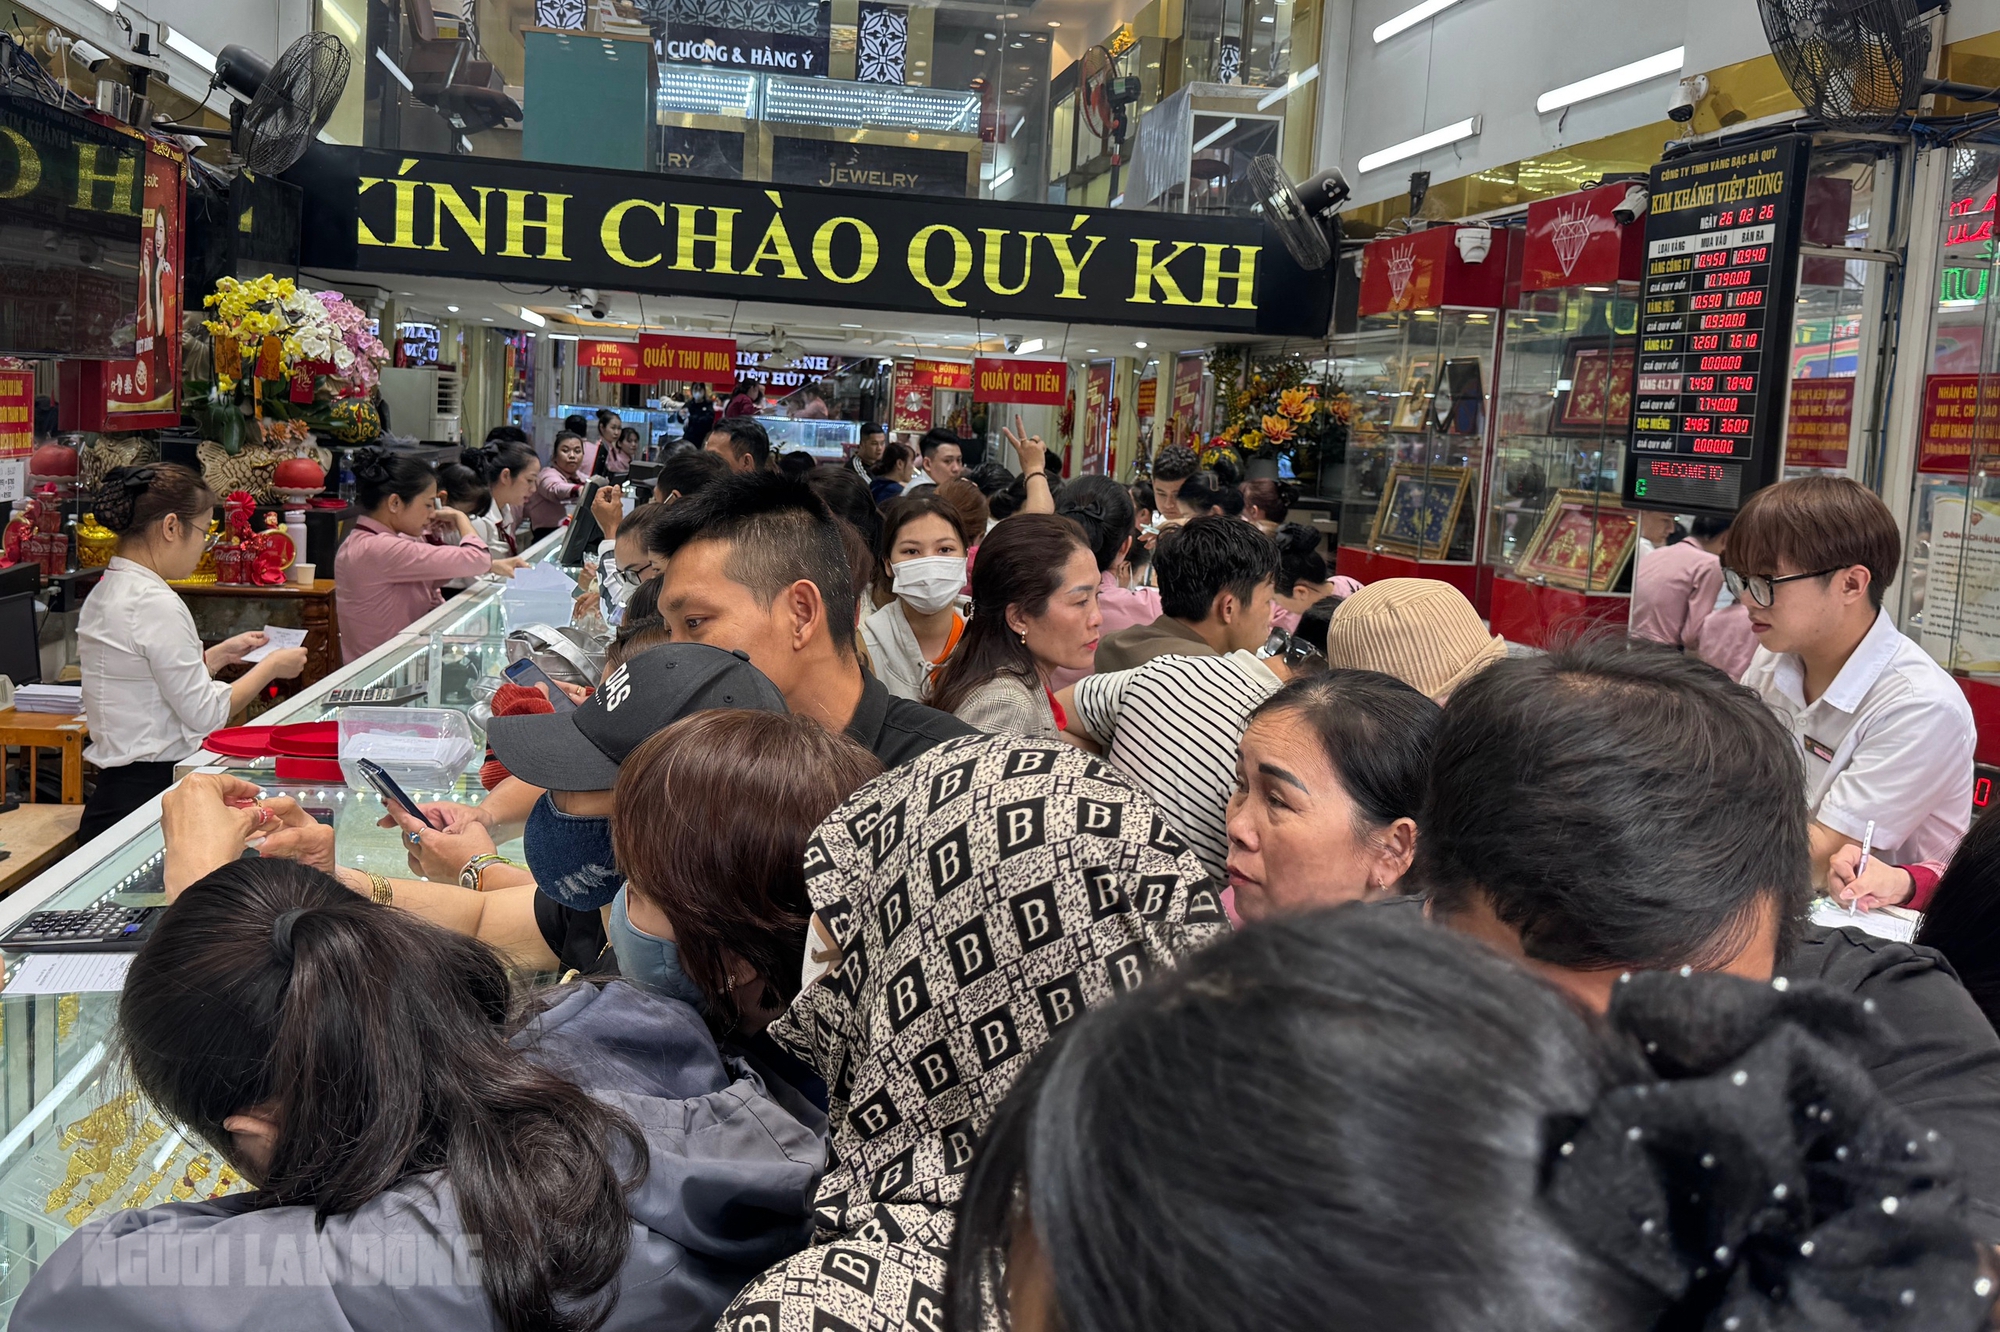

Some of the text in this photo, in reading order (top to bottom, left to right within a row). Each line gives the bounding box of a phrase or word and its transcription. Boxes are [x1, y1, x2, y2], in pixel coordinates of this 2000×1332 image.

[732, 47, 747, 64] &
[750, 45, 797, 69] HÀNG
[802, 50, 814, 70] Ý
[1661, 167, 1679, 182] CÔNG
[1680, 166, 1689, 178] TY
[1691, 162, 1709, 175] TNHH
[1710, 157, 1730, 171] VÀNG
[1731, 154, 1747, 170] BẠC
[1761, 146, 1778, 162] QUÝ
[1650, 169, 1784, 215] KIM KHÁNH VIỆT HÙNG
[1719, 211, 1734, 227] 26
[1738, 207, 1755, 223] 02
[1758, 204, 1775, 220] 26
[600, 190, 879, 284] CHÀO
[907, 214, 1106, 309] QUÝ
[1125, 238, 1264, 310] KH
[1658, 229, 1765, 256] LOẠI VÀNG MUA VÀO BÁN RA
[1682, 258, 1692, 271] TY
[596, 342, 620, 355] VÒNG,
[1644, 338, 1660, 351] VÀNG
[608, 358, 623, 368] TAY
[678, 350, 701, 370] THU
[703, 352, 731, 372] MUA
[1013, 373, 1032, 392] CHI
[1035, 368, 1060, 393] TIỀN
[1640, 377, 1657, 391] VÀNG
[1657, 379, 1671, 391] 41.7
[1672, 379, 1680, 390] W
[1637, 417, 1650, 431] BẠC
[1650, 414, 1671, 431] MIẾNG
[1013, 749, 1045, 773] B
[935, 768, 966, 803] B
[1004, 808, 1034, 844] B
[1083, 802, 1111, 830] B
[935, 839, 961, 886] B
[881, 893, 904, 935] B
[1020, 898, 1049, 940] B
[957, 932, 984, 977] B
[890, 976, 919, 1021] B
[1045, 986, 1072, 1024] B
[983, 1019, 1011, 1060] B
[919, 1056, 948, 1090] B
[858, 1104, 889, 1135] B
